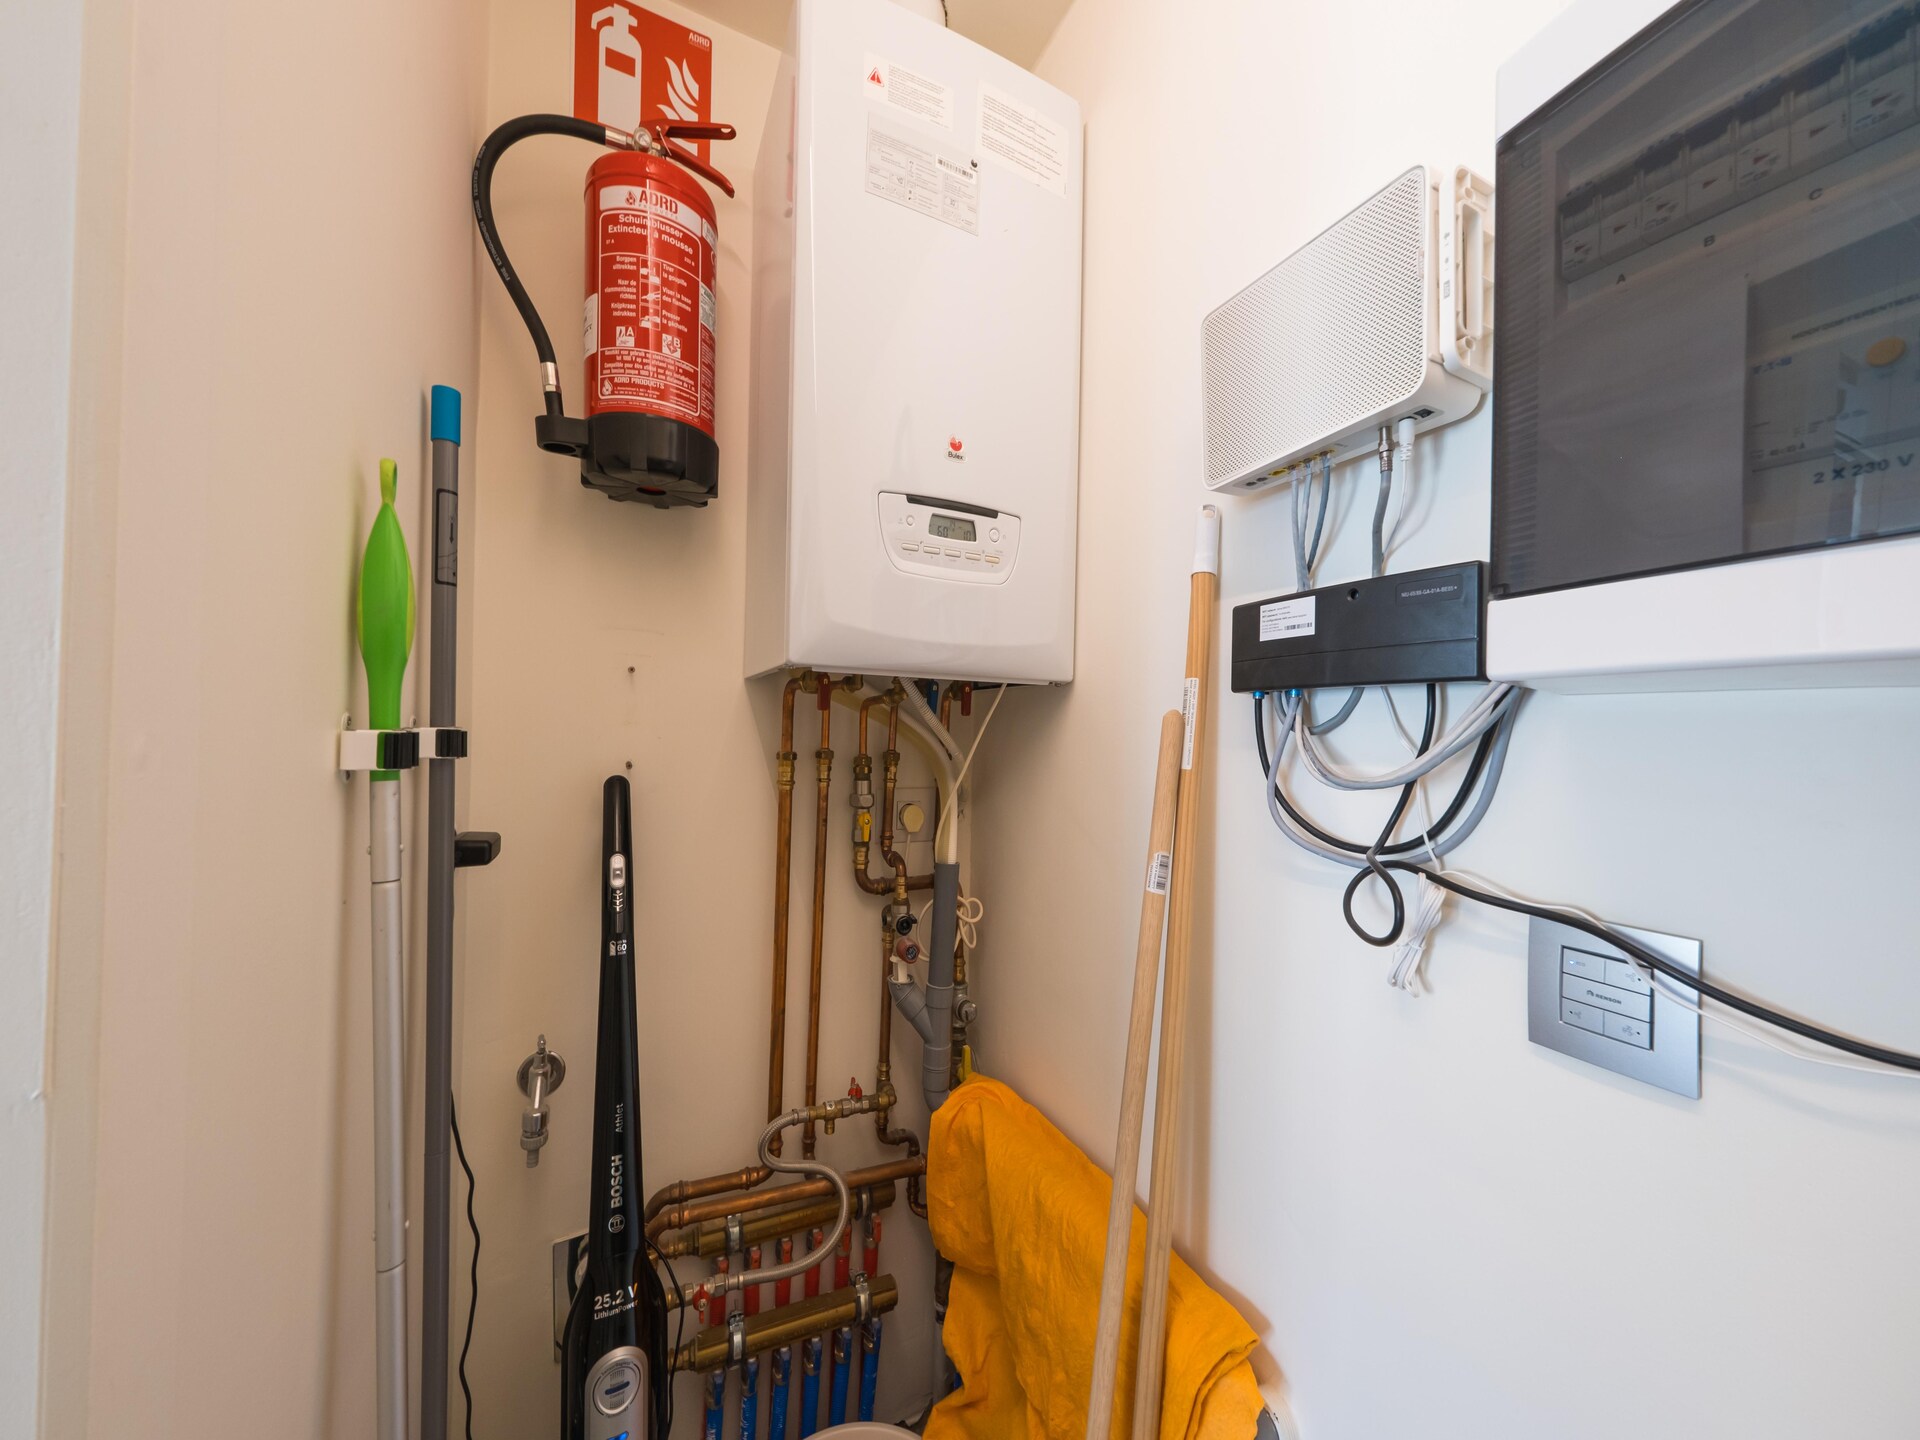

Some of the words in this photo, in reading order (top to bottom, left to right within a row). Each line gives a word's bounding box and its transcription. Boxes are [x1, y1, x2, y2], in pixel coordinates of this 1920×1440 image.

[1808, 188, 1824, 200] C
[608, 224, 650, 236] Extincteu
[662, 234, 693, 255] mousse
[1704, 234, 1716, 248] B
[1616, 274, 1626, 284] A
[626, 326, 634, 337] A
[674, 336, 680, 348] B
[631, 378, 664, 389] PRODUCTS
[948, 450, 964, 461] Bulex
[1812, 472, 1825, 484] 2
[1850, 458, 1890, 477] 230
[1896, 452, 1914, 466] V
[617, 943, 627, 951] 60
[616, 1103, 624, 1132] Athlet
[611, 1154, 622, 1208] BOSCH
[594, 1289, 624, 1310] 25.2
[628, 1282, 638, 1298] V
[594, 1299, 639, 1320] LithiumPower
